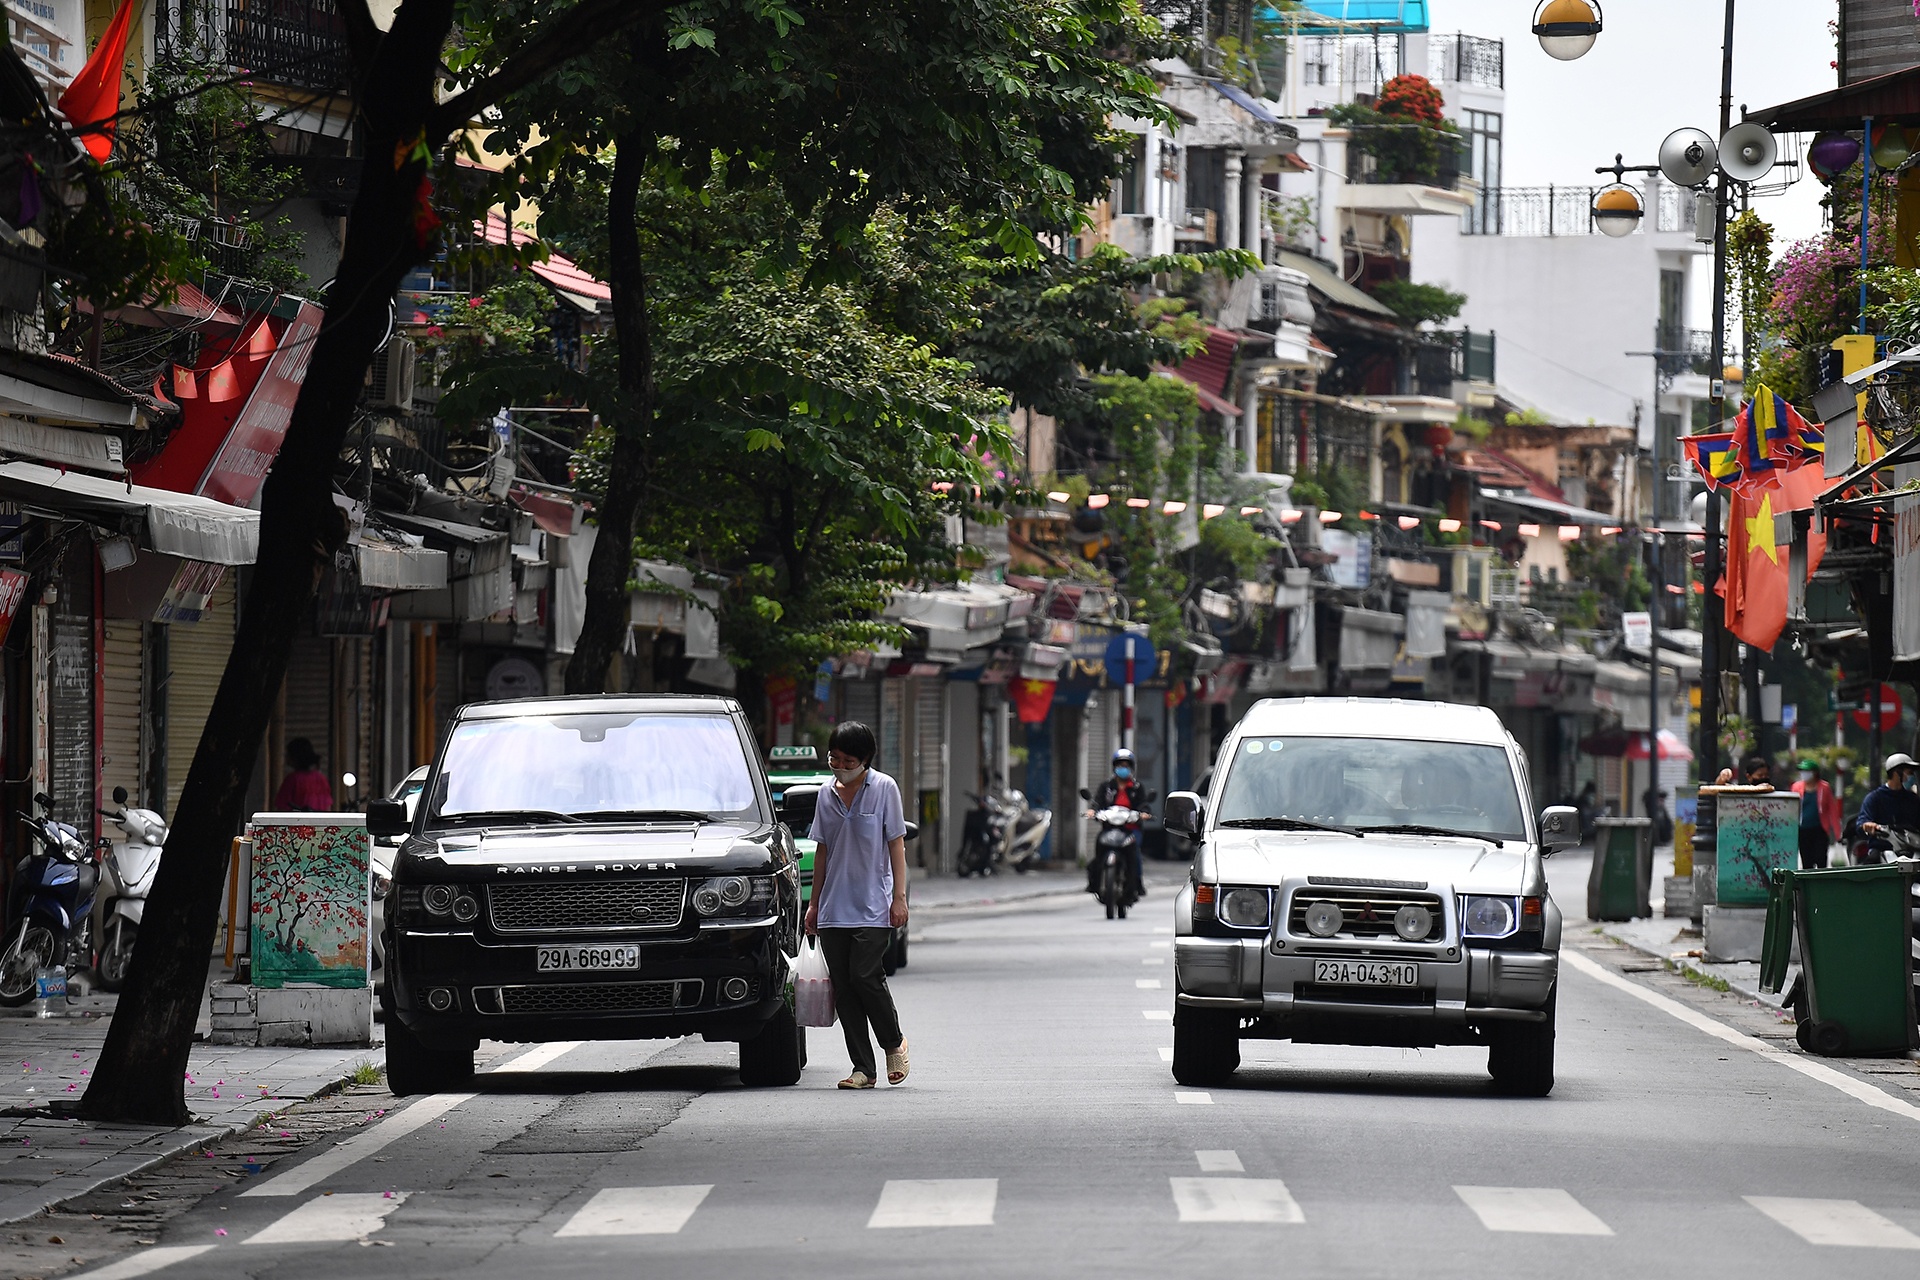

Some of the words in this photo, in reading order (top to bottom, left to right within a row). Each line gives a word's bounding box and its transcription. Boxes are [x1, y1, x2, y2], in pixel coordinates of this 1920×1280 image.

[775, 747, 810, 756] TAXI
[496, 866, 578, 875] RANGE
[594, 862, 677, 872] ROVER
[538, 948, 637, 970] 29A-669.99
[1317, 962, 1415, 985] 23A-043.10
